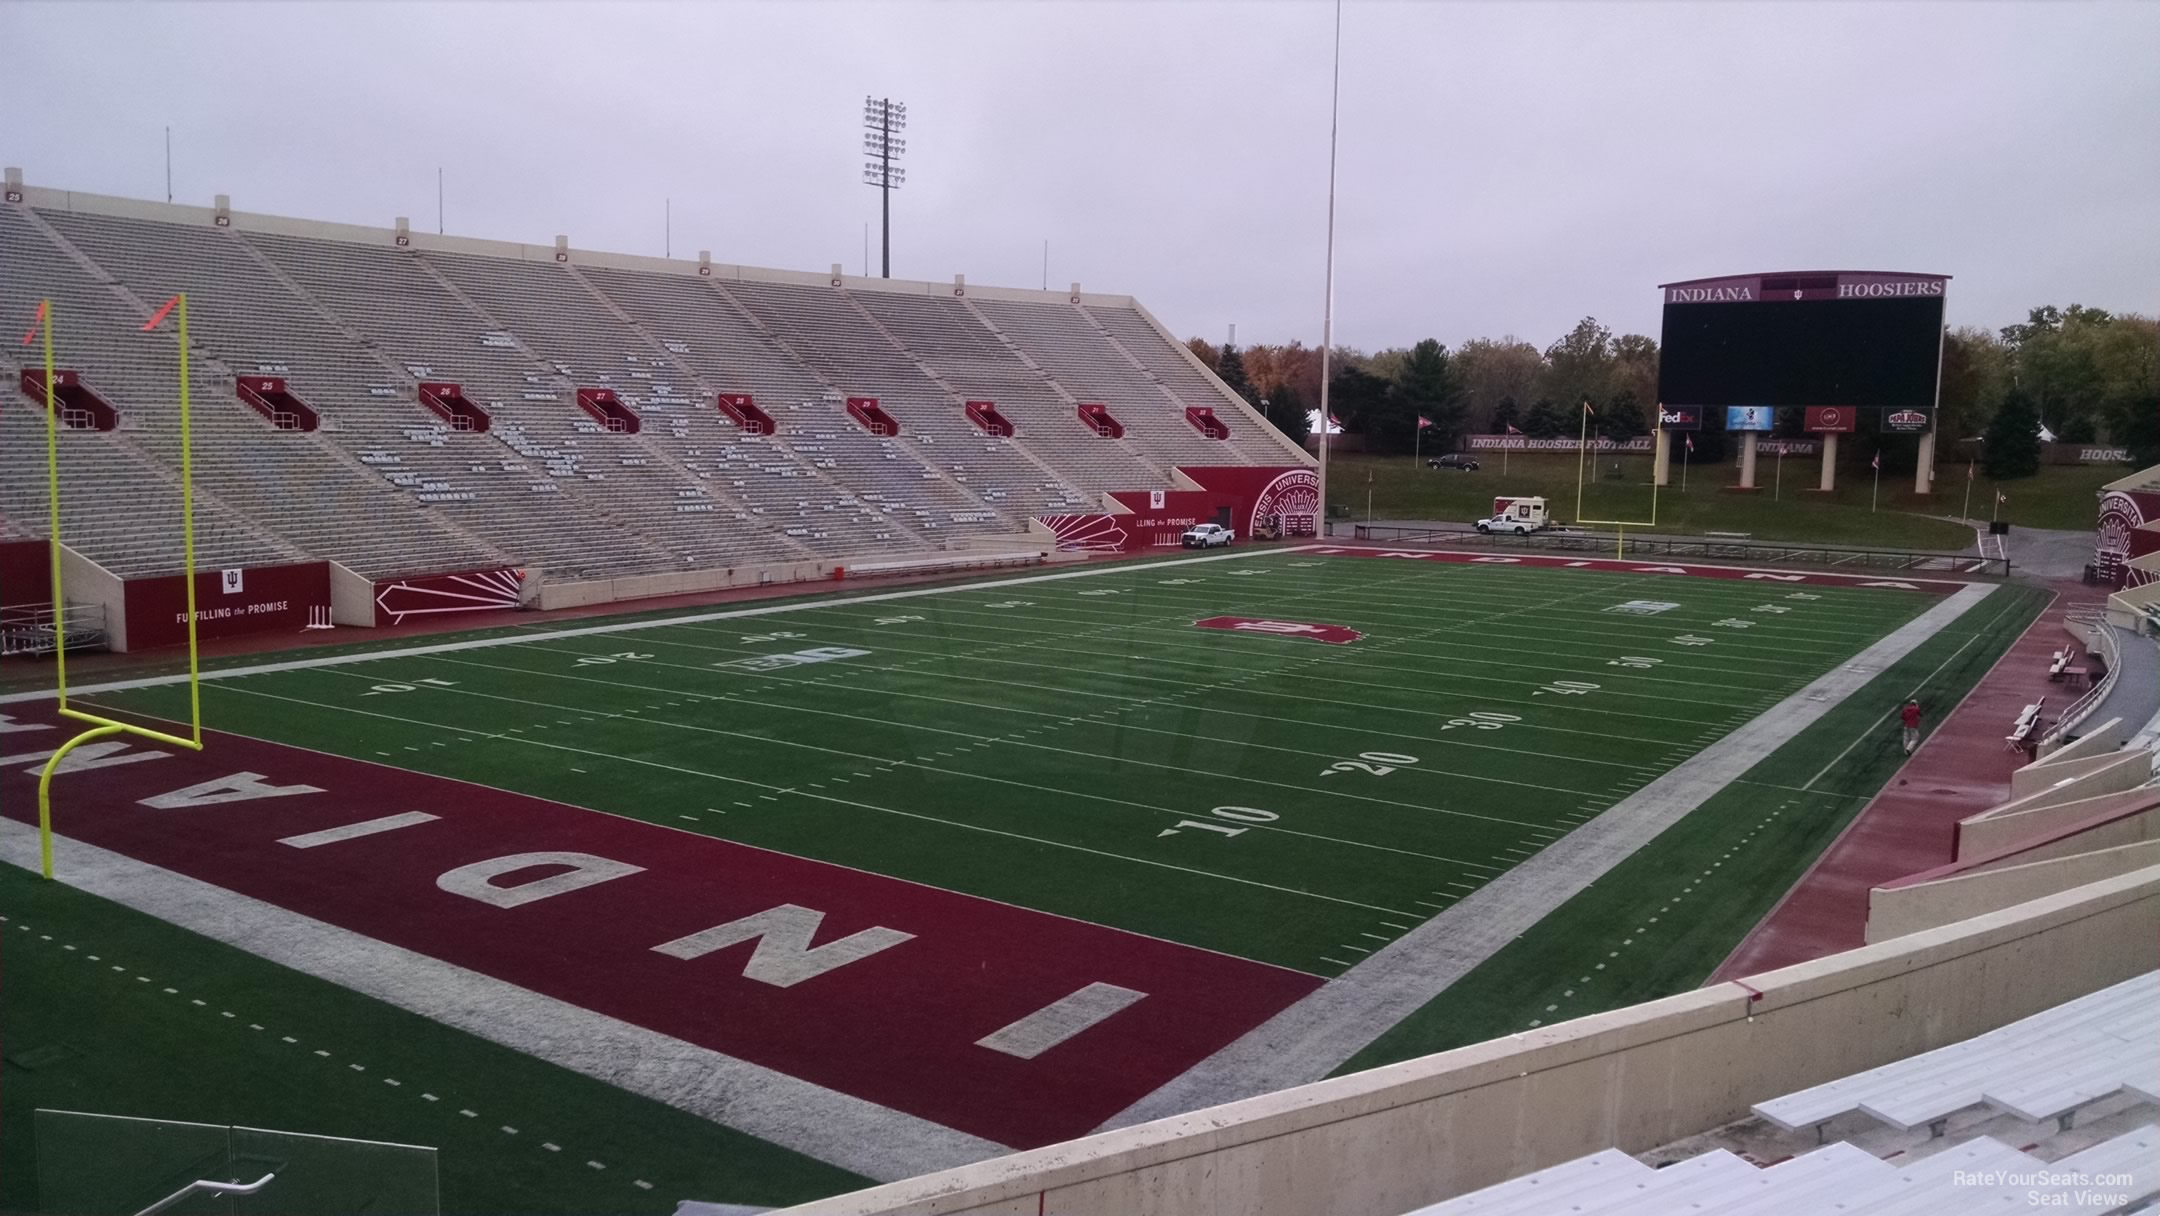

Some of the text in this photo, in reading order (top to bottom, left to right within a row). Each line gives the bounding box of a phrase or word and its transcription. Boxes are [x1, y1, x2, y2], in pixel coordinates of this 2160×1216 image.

[8, 193, 20, 201] 25
[217, 217, 228, 225] 26
[1671, 287, 1752, 302] INDIANA
[1839, 281, 1942, 298] HOOSIERS
[52, 375, 64, 384] 24
[261, 382, 273, 390] 25
[440, 387, 451, 395] 26
[596, 392, 606, 400] 27
[1660, 411, 1694, 423] FedEx
[1472, 438, 1525, 449] INDIANA
[1527, 439, 1583, 449] HOOSIER
[1757, 441, 1814, 453] INDIANA
[1167, 517, 1196, 526] PROMISE
[176, 600, 288, 623] FUFILLING the PROMISE
[576, 651, 656, 664] 20
[370, 677, 461, 693] 10
[1540, 680, 1601, 695] 40
[1448, 711, 1522, 730] 30
[1331, 751, 1419, 777] 20
[1174, 805, 1280, 838] 10
